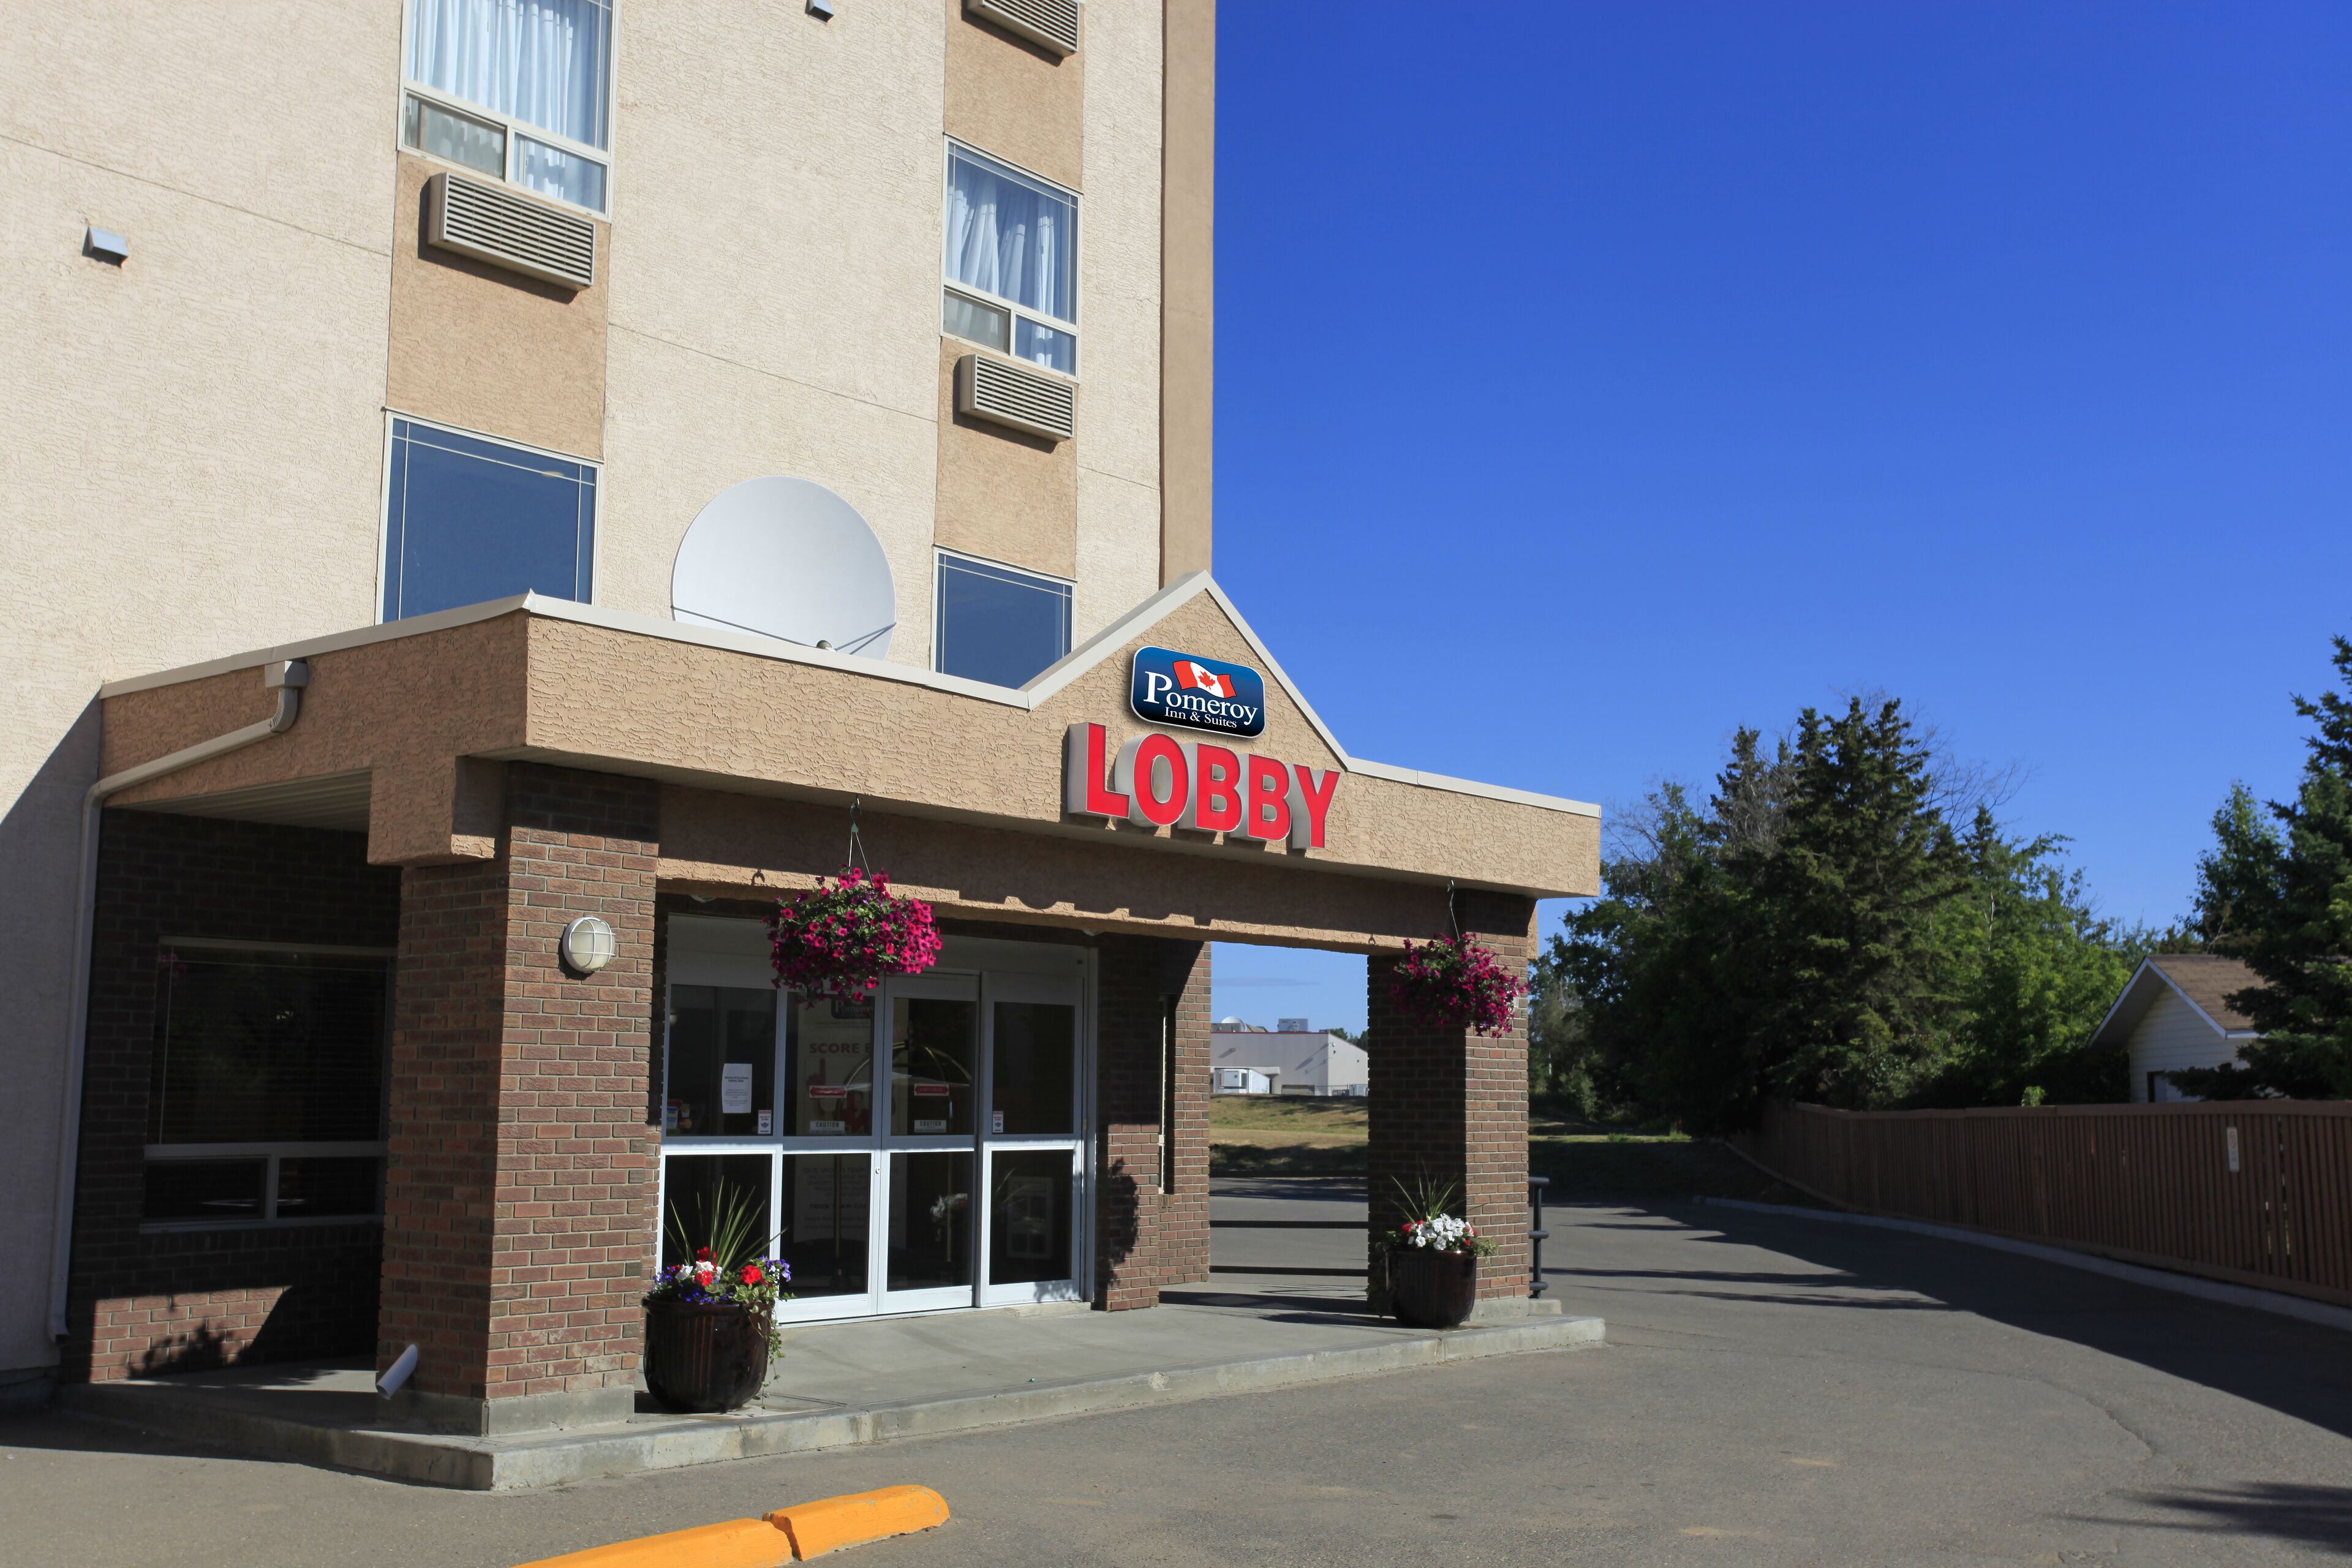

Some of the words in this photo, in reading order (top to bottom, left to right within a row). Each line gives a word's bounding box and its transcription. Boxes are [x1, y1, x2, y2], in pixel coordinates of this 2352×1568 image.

[1143, 671, 1259, 725] Pomeroy
[1164, 706, 1187, 720] Inn
[1189, 711, 1200, 722] &
[1204, 714, 1237, 728] Suites
[1087, 722, 1341, 849] LOBBY
[809, 1043, 860, 1054] SCORE
